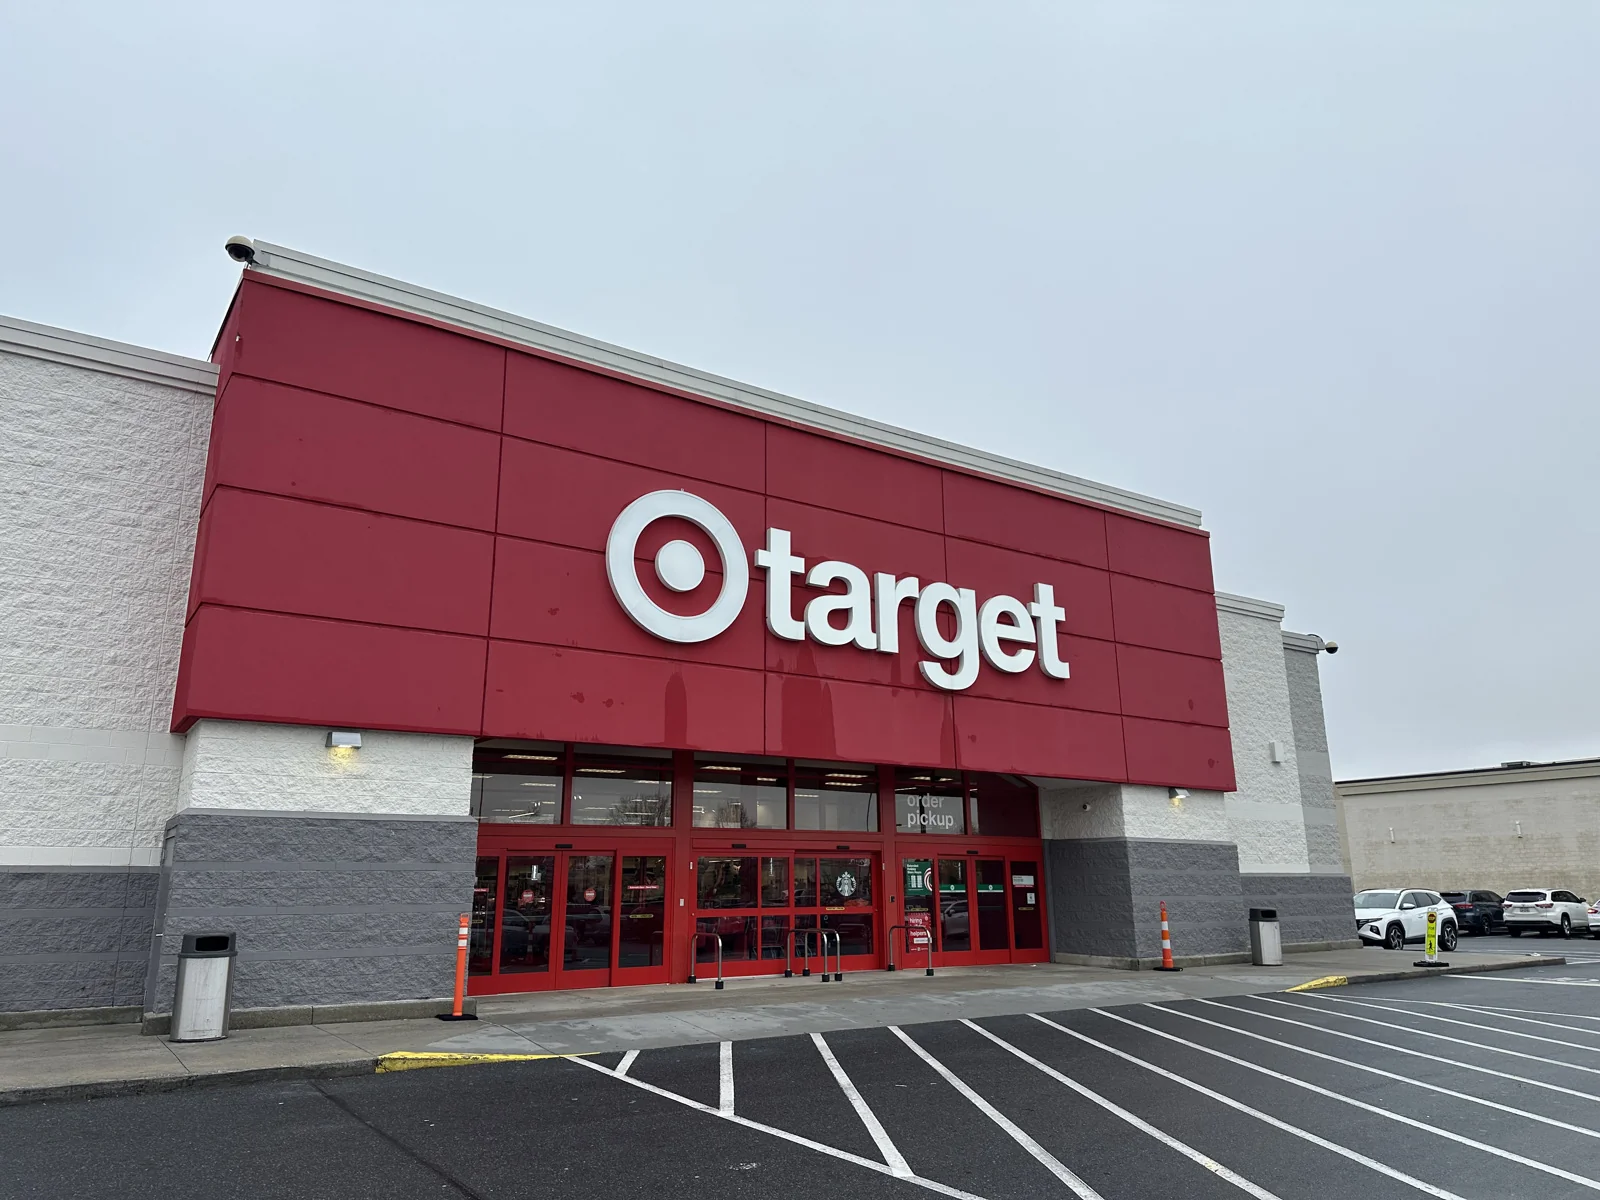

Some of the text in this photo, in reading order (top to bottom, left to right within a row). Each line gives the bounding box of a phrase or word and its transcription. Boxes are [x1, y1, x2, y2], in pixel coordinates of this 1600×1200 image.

[754, 527, 1070, 691] target
[907, 793, 945, 808] order
[907, 809, 954, 829] pickup
